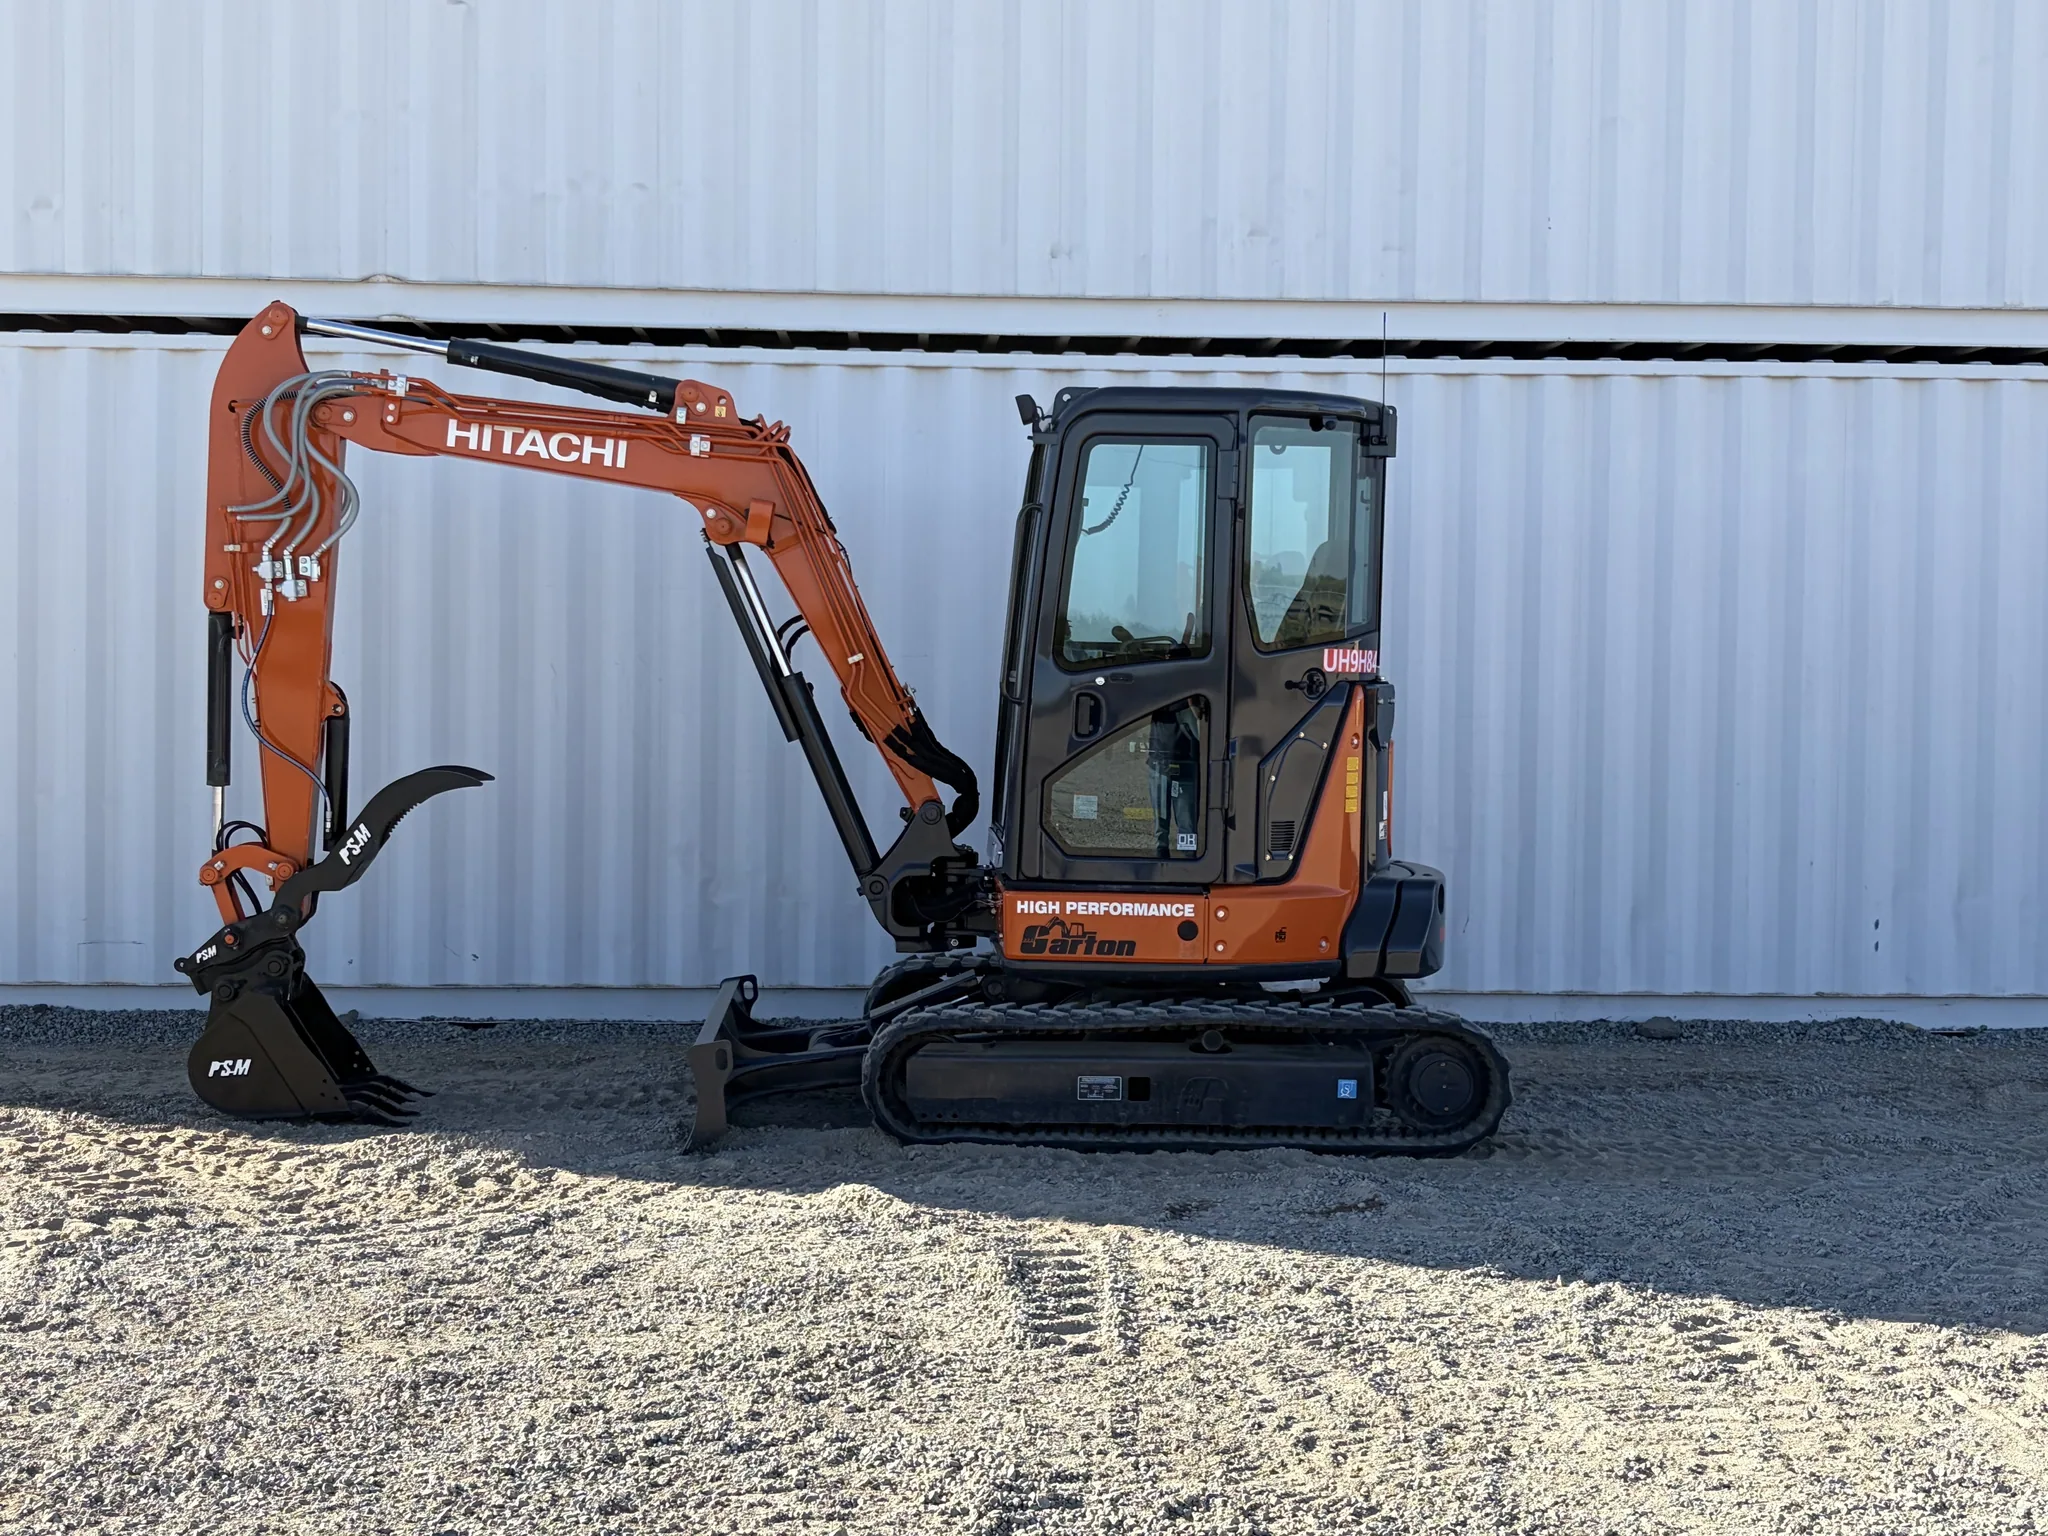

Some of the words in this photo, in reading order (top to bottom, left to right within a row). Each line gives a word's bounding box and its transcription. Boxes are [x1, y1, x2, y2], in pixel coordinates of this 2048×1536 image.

[446, 418, 628, 469] HITACHI
[338, 822, 372, 866] PSM
[1016, 900, 1060, 914] HIGH
[1065, 901, 1195, 917] PERFORMANCE
[1020, 922, 1137, 957] Garton
[196, 944, 217, 964] PSM
[207, 1058, 252, 1078] PSM
